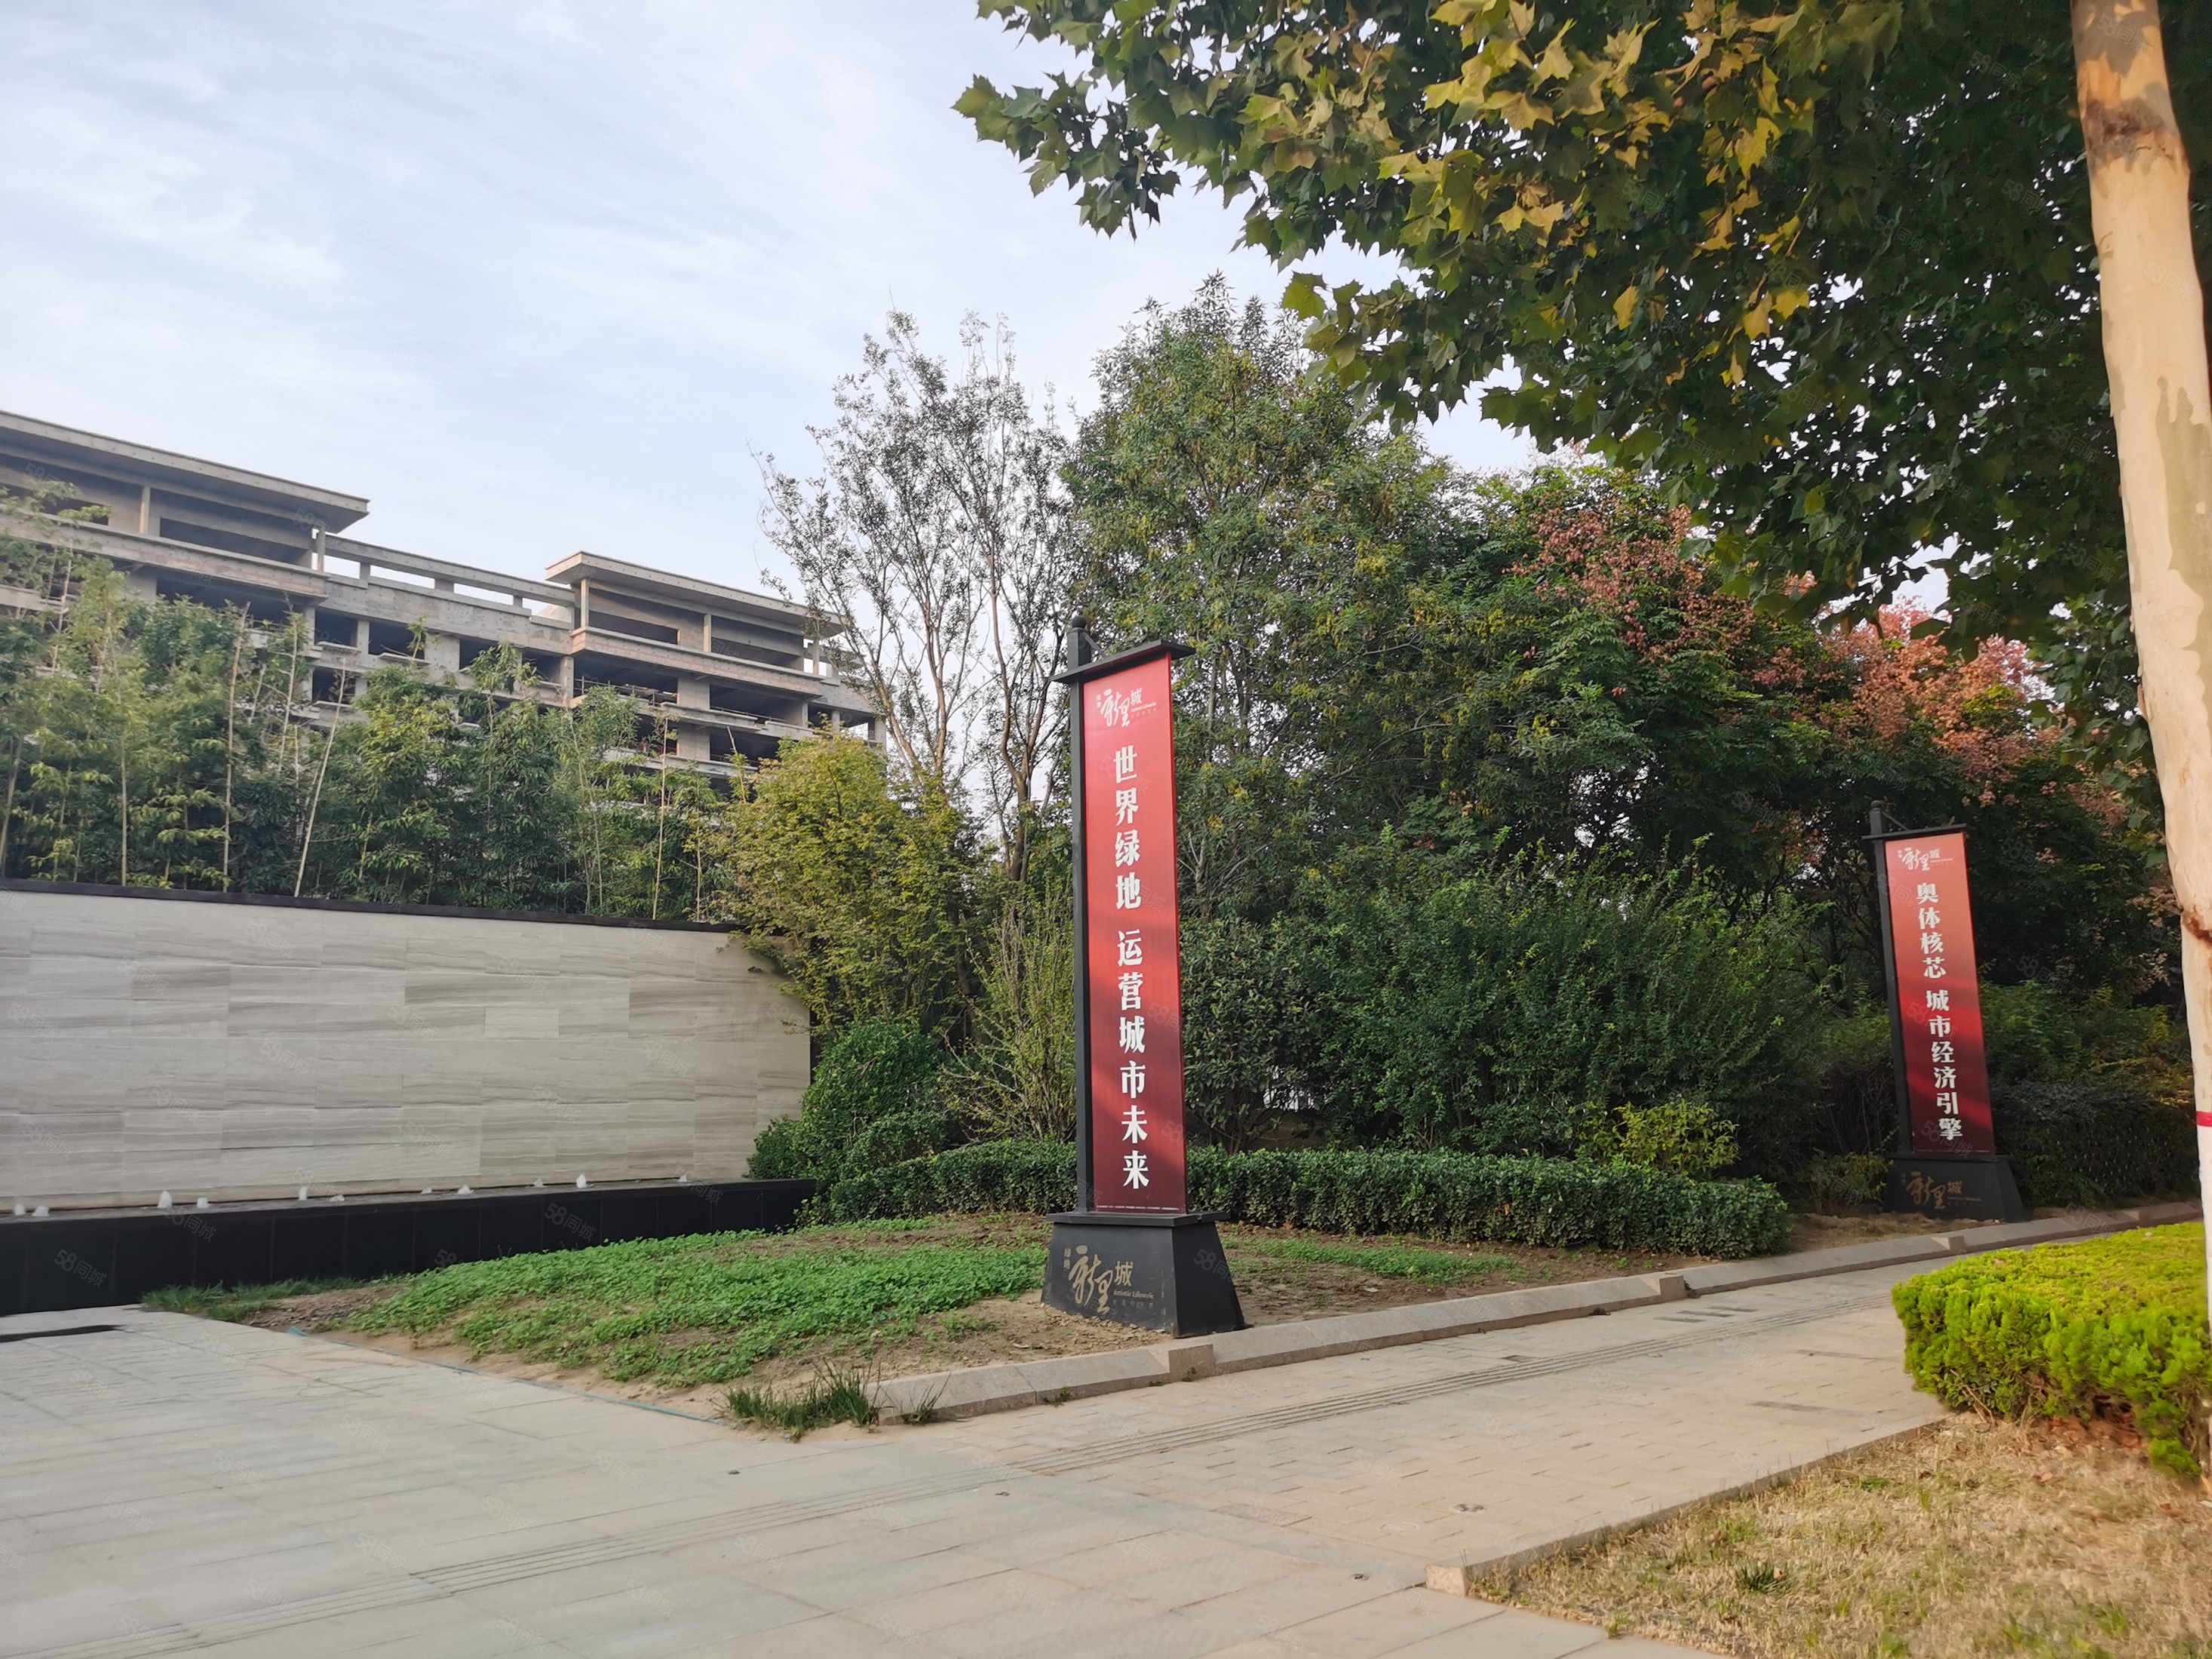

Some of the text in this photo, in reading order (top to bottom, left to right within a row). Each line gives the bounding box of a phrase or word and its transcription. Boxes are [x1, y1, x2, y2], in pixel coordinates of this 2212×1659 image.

[1113, 745, 1150, 1189] 世界绿地 运营城市未来
[1916, 882, 1947, 980] 奥体核芯
[1925, 989, 1963, 1142] 城市经济引擎
